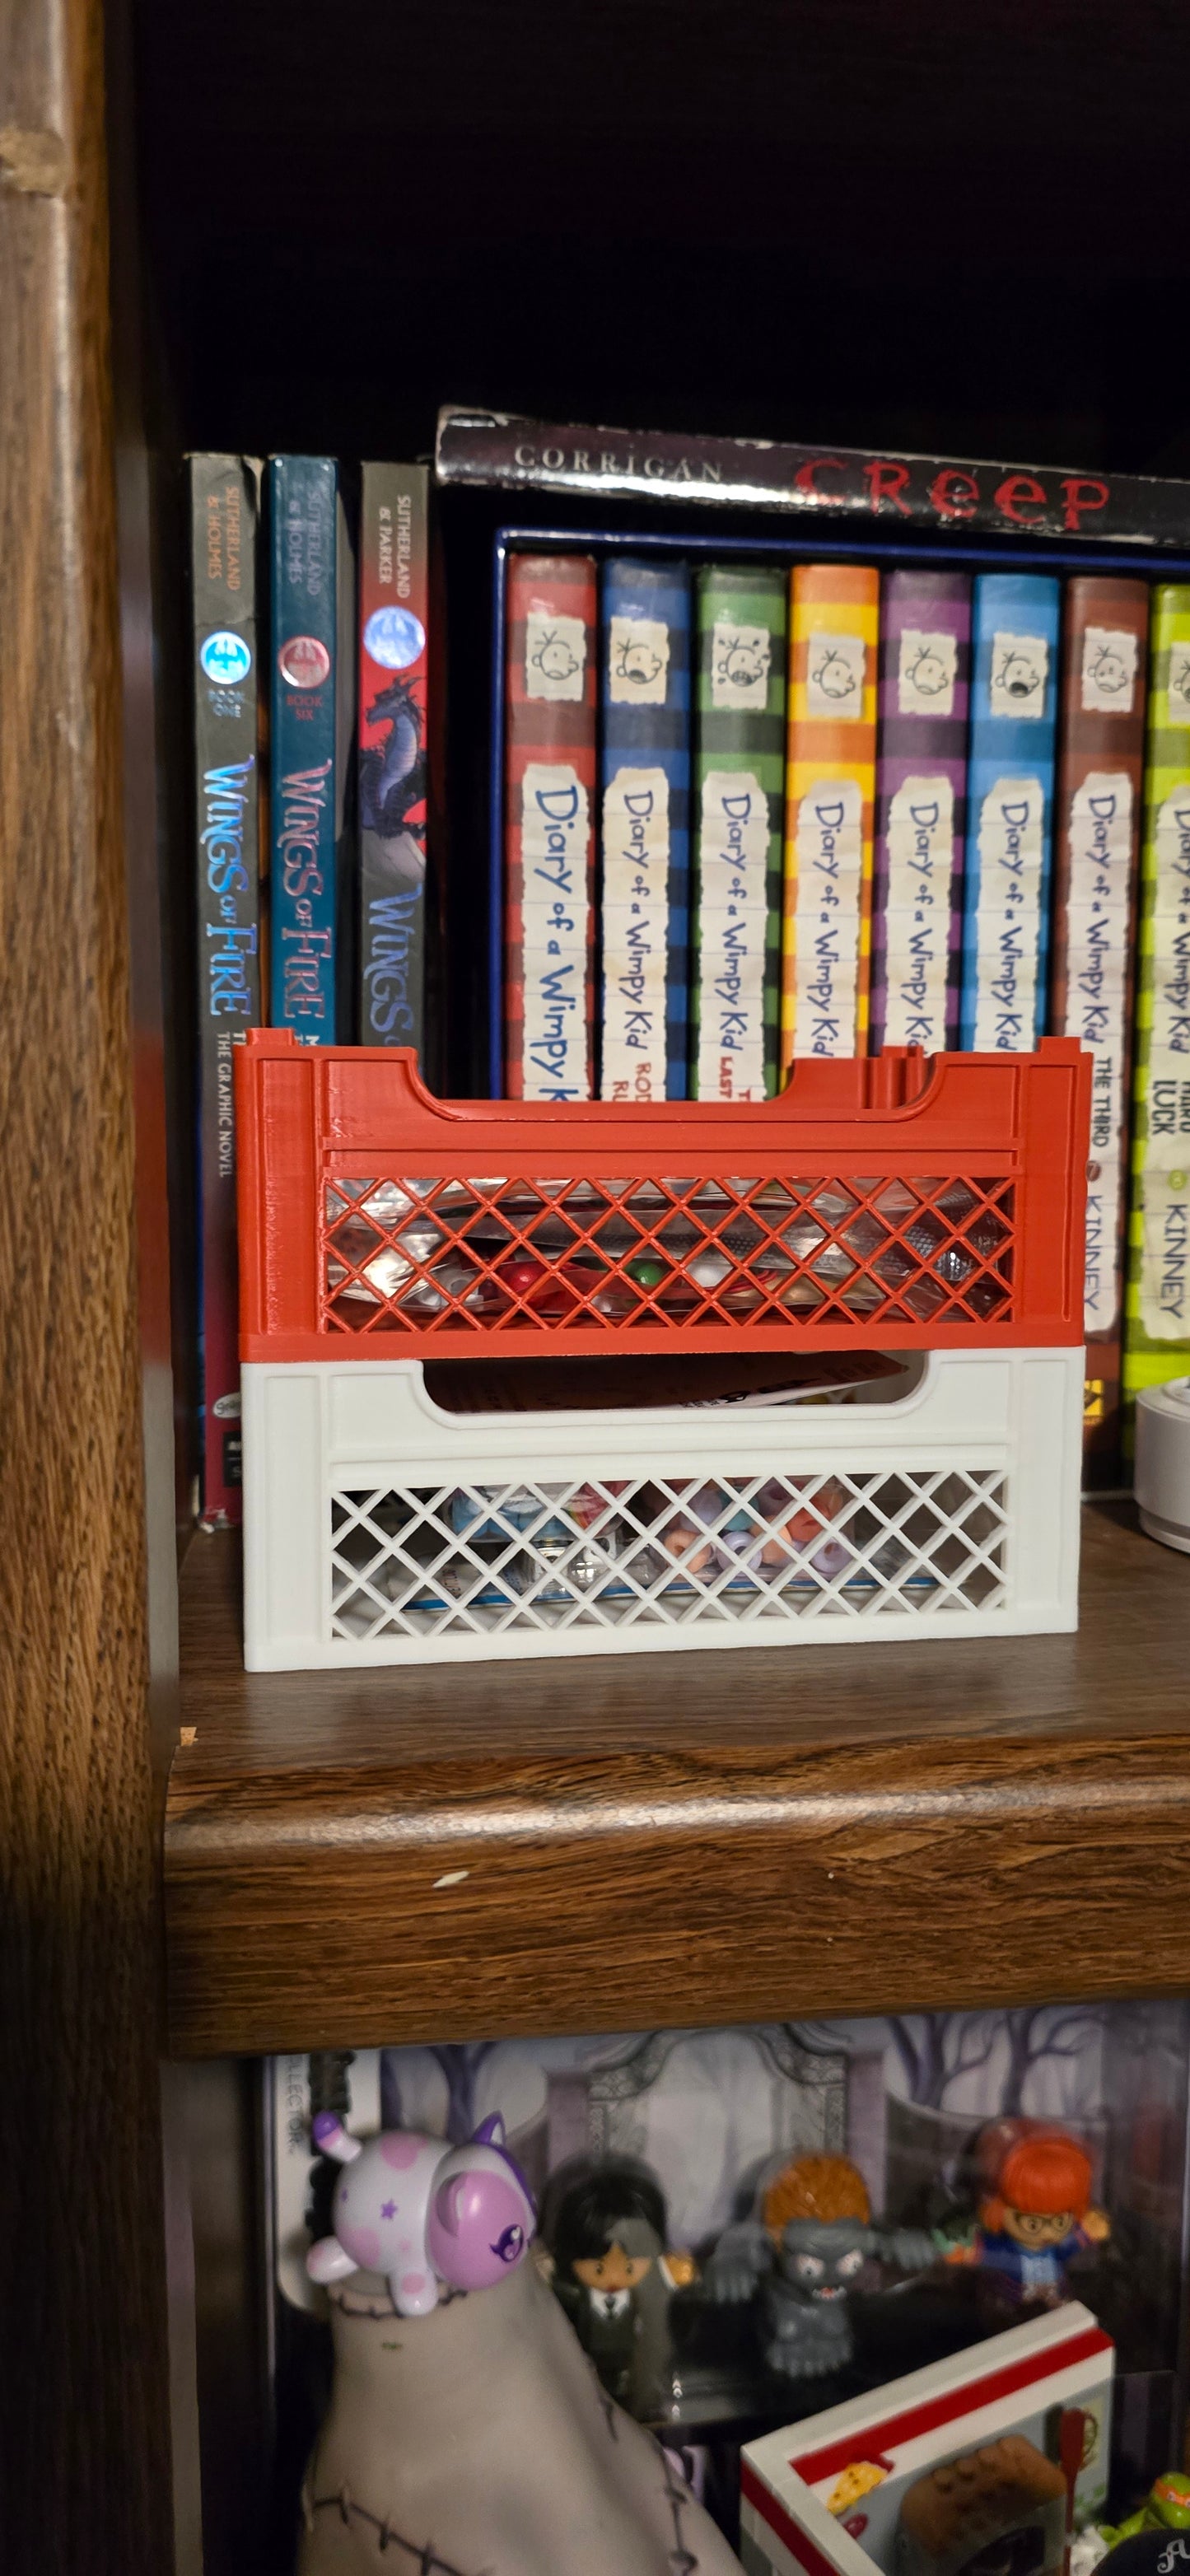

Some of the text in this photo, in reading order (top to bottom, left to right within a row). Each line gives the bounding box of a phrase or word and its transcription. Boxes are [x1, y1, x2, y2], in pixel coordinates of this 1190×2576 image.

[514, 445, 723, 483] CORRIGAN
[208, 494, 222, 581] & HOLMES
[225, 486, 241, 591] SUTHERLAND
[287, 518, 303, 585] HOLMES
[306, 491, 322, 597] SUTHERLAND
[378, 506, 393, 585] & PARKER
[396, 495, 412, 598] SUTHERLAND
[286, 693, 323, 707] BOOK
[296, 707, 314, 721] SIX
[199, 754, 255, 894] WINGS
[277, 758, 333, 898] WINGS
[534, 785, 578, 894] Diary
[907, 801, 939, 878] Diary
[547, 903, 574, 931] of
[618, 791, 654, 1050] Diary of a Wimpy Kid
[715, 793, 751, 1051] Diary of a Wimpy Kid
[807, 801, 844, 1057] Diary of a Wimpy Kid
[914, 884, 934, 906] of
[914, 911, 924, 922] a
[991, 801, 1029, 1052] Diary of a Wimpy Kid
[1078, 794, 1116, 1044] Diary of a Wimpy Kid
[1178, 912, 1188, 924] a
[206, 922, 258, 1016] FIRE
[281, 926, 332, 1019] FIRE
[363, 882, 423, 1033] WINGS
[548, 940, 561, 955] a
[900, 928, 933, 1010] Wimpy
[1163, 931, 1190, 1010] Wimpy
[530, 964, 576, 1078] Wimpy
[1167, 1015, 1190, 1054] Kid
[217, 1031, 233, 1178] THE GRAPHIC NOVEL
[719, 1056, 734, 1099] LAST
[1092, 1057, 1112, 1148] THE THIRD
[1151, 1079, 1178, 1136] LUCK
[1160, 1203, 1188, 1320] KINNEY
